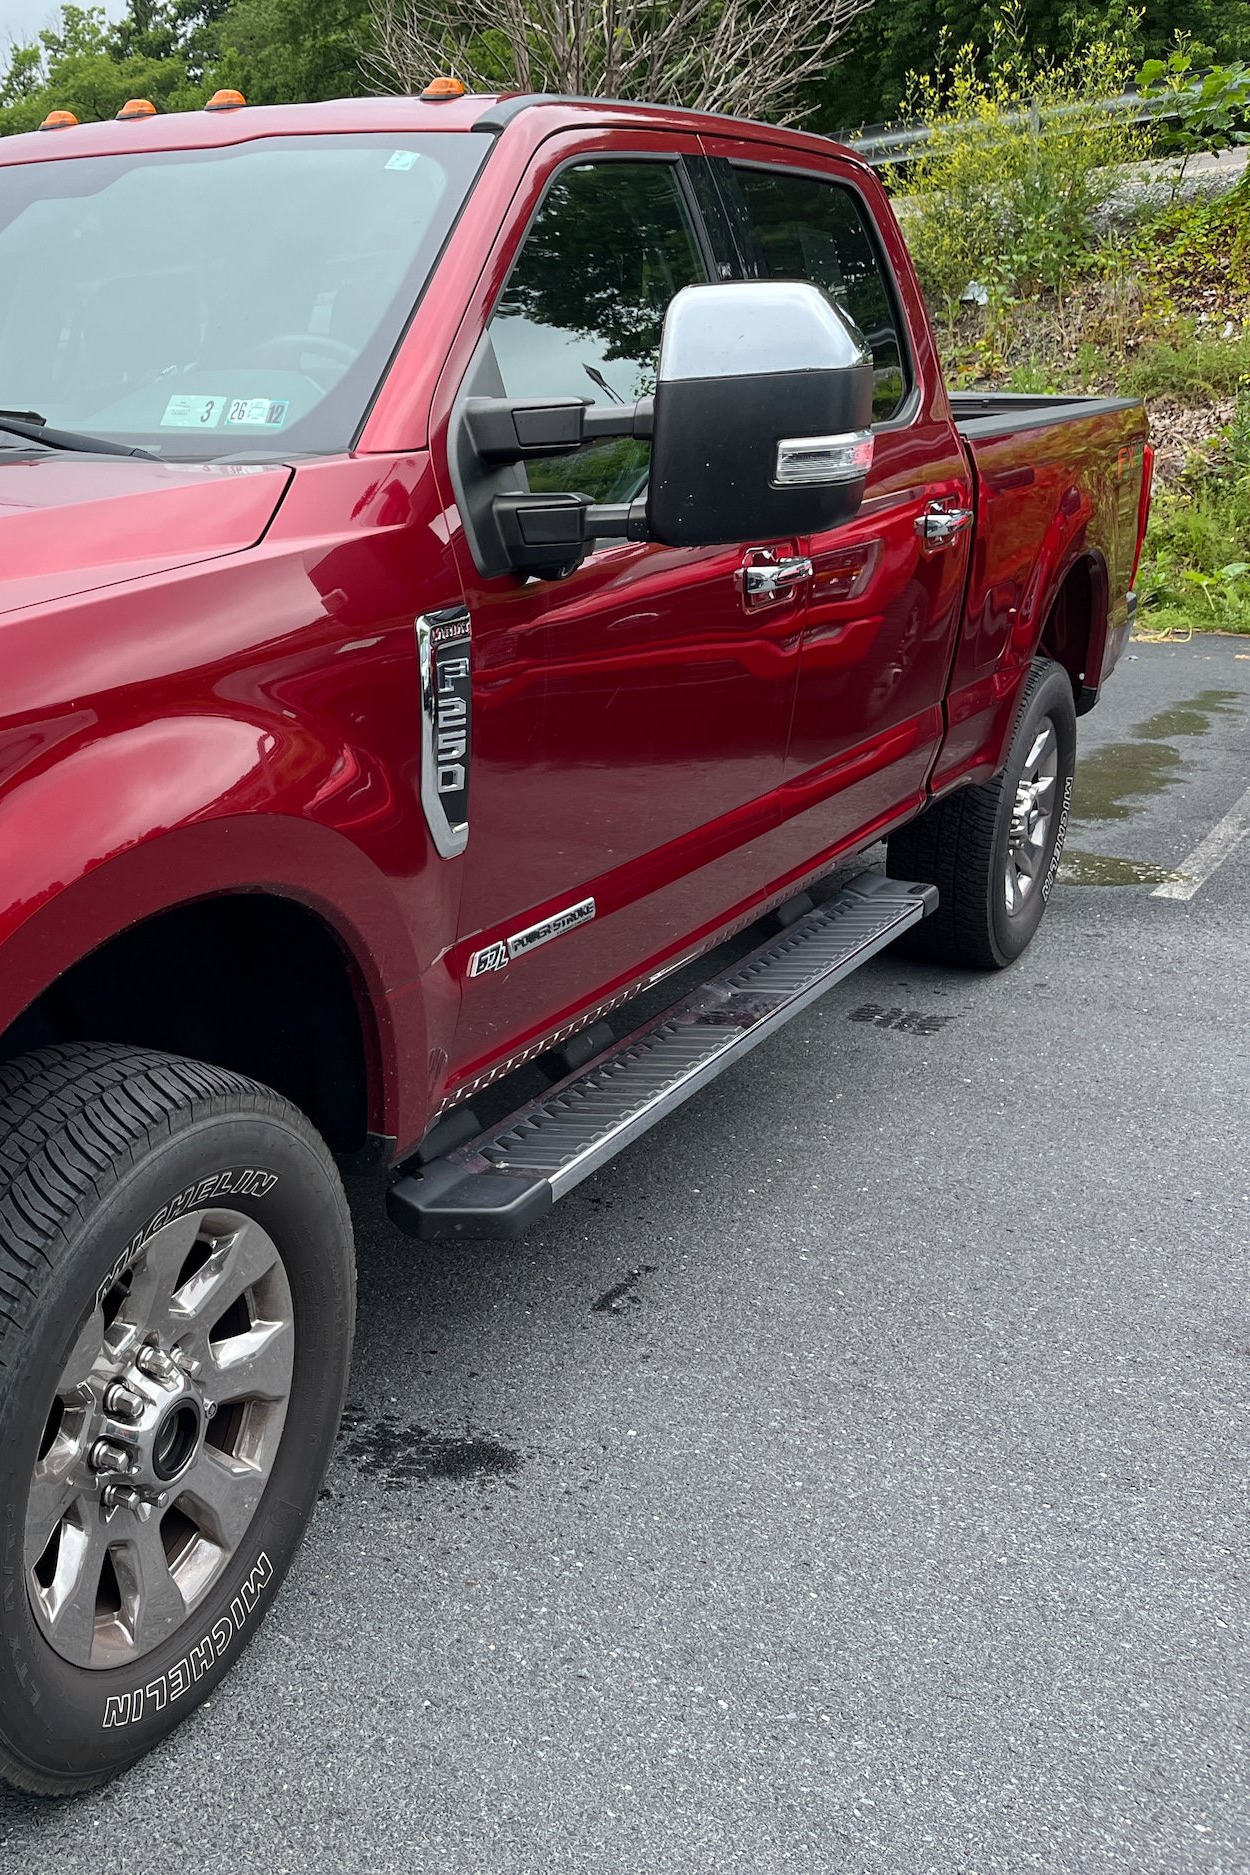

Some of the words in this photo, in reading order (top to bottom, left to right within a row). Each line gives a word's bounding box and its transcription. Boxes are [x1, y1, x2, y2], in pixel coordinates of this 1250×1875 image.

[201, 401, 215, 423] 3
[230, 402, 248, 420] 26
[1042, 776, 1074, 902] MICHELIN
[511, 924, 551, 952] POWER
[553, 902, 594, 932] STROKE
[94, 1170, 279, 1312] MICHELIN
[102, 1551, 274, 1728] MICHELIN
